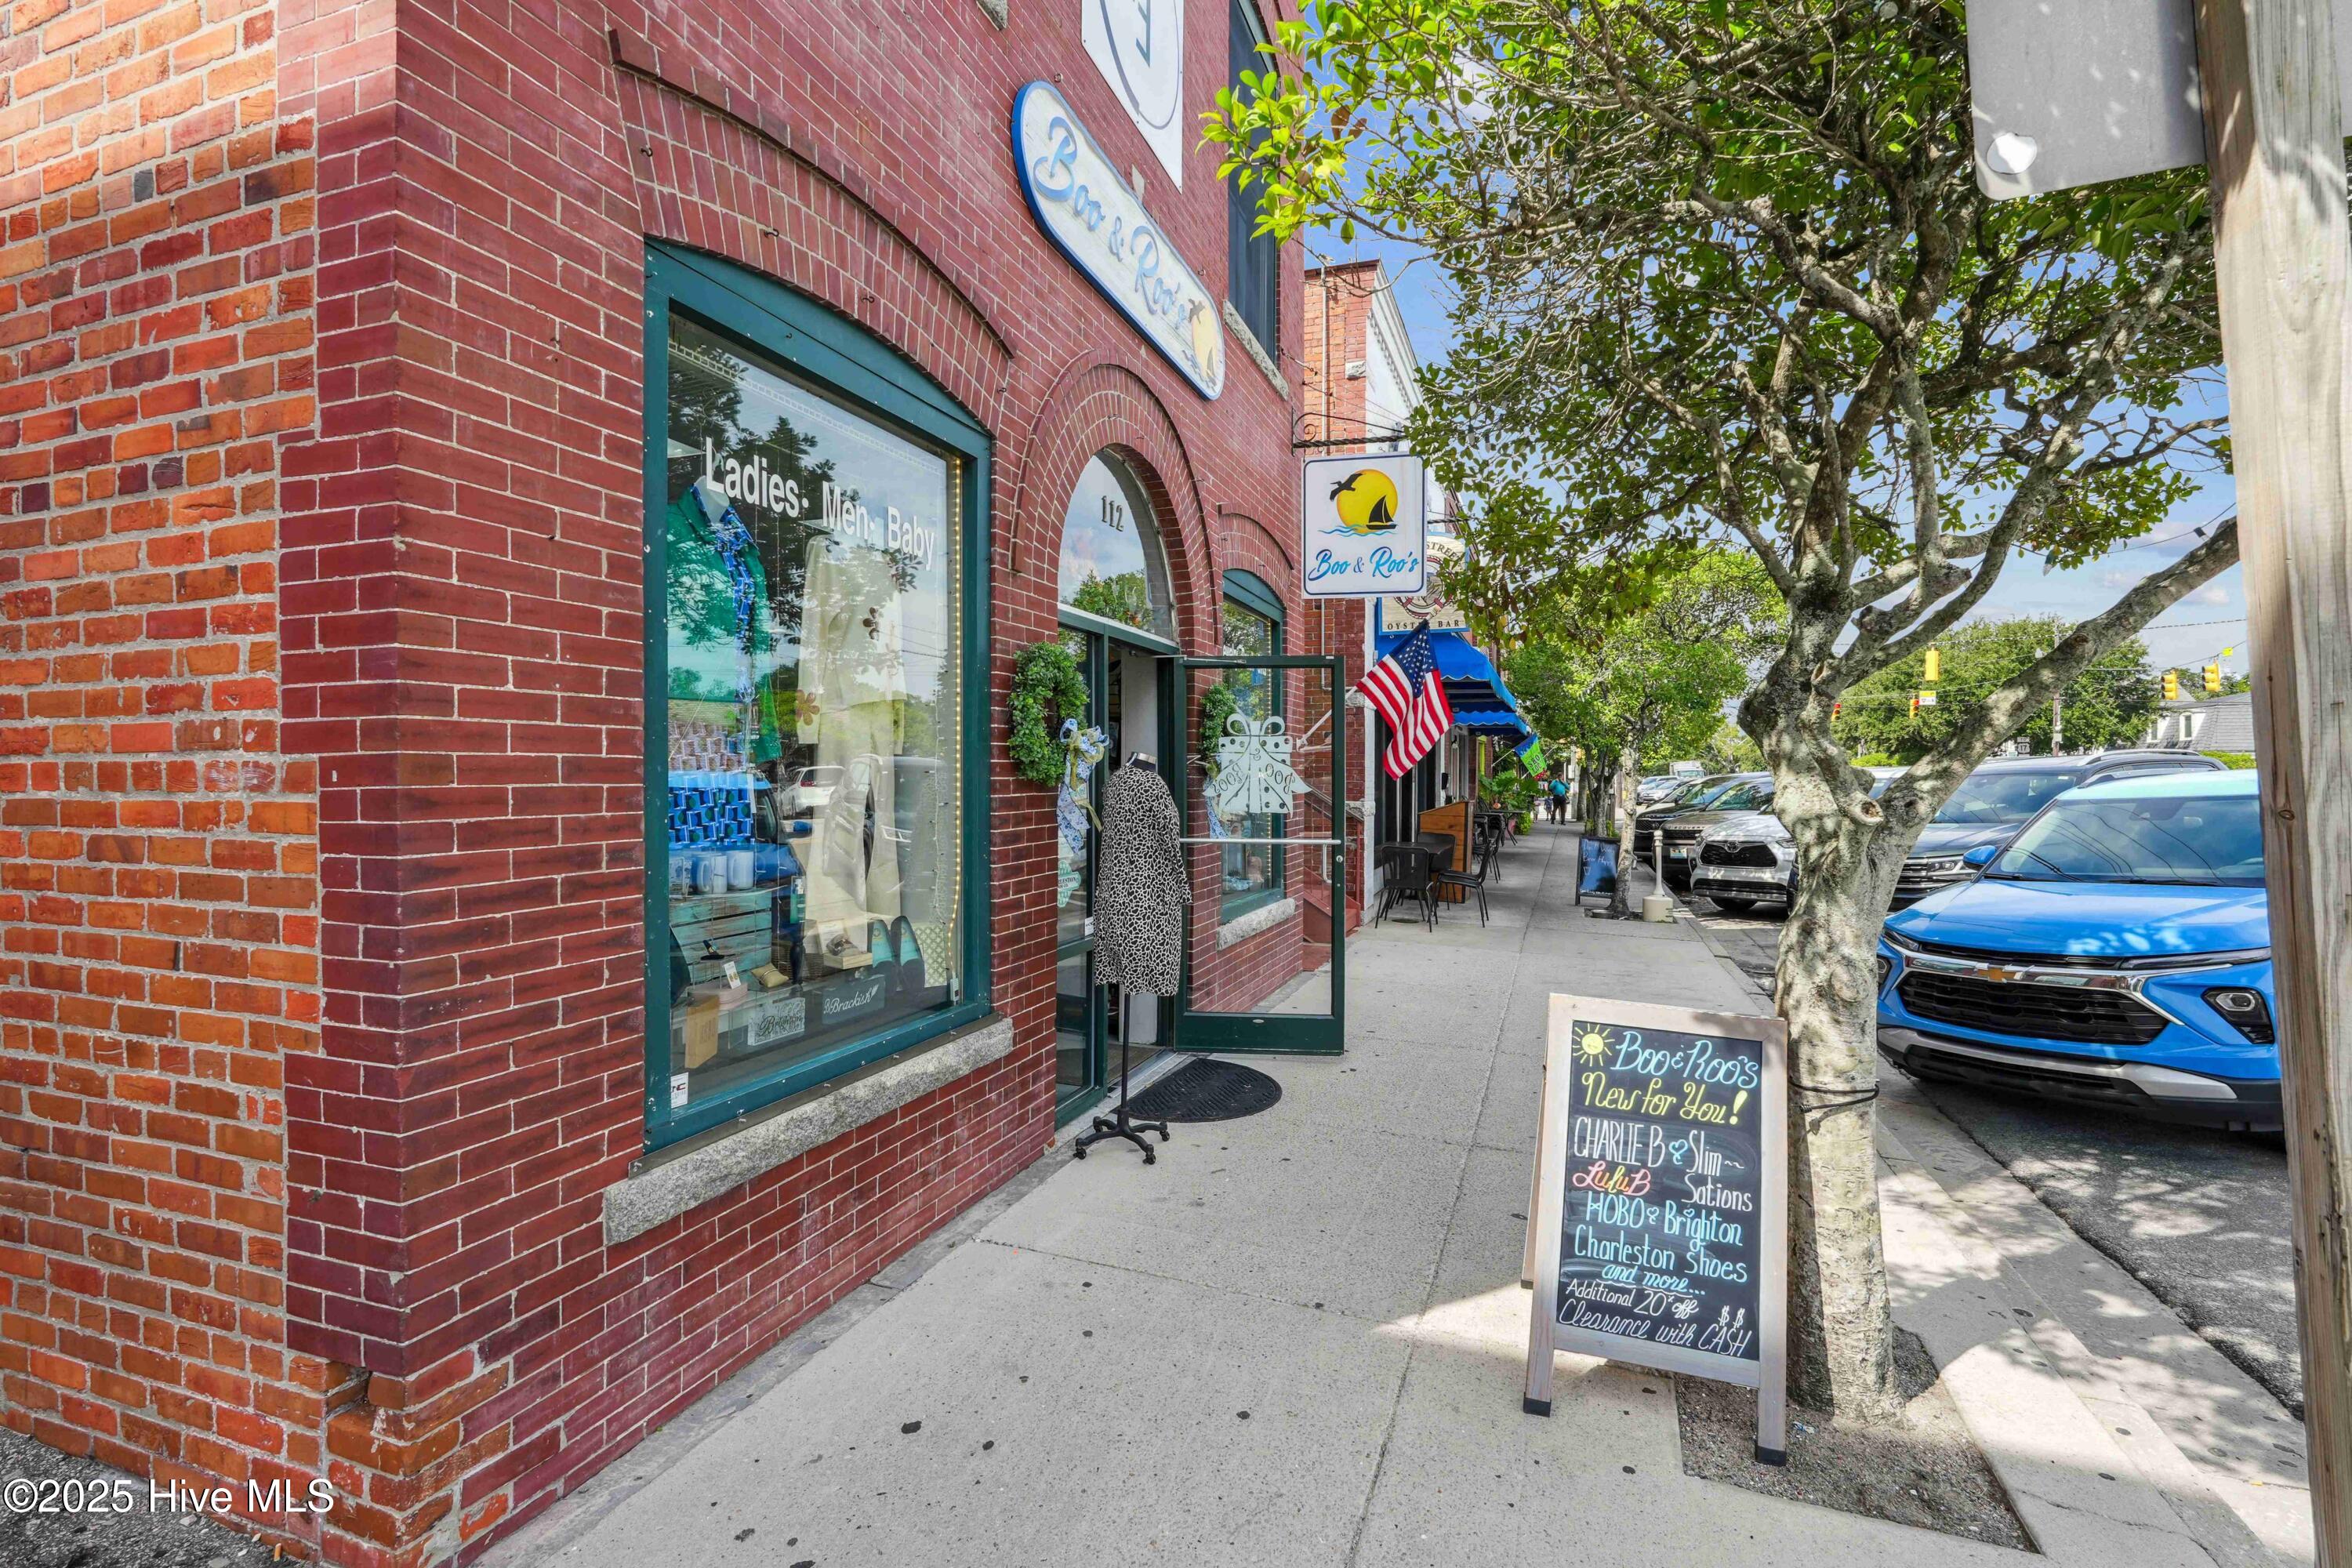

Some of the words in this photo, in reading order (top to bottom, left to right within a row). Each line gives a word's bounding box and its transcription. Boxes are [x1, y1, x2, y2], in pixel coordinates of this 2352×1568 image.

[1033, 116, 1106, 232] Boo
[1109, 216, 1124, 263] &
[1131, 225, 1187, 330] Roo's
[1102, 495, 1124, 532] 112
[887, 505, 935, 572] Baby
[1426, 541, 1458, 560] STREE
[1308, 549, 1350, 581] Boo
[1353, 557, 1364, 573] &
[1369, 546, 1419, 579] Roo's
[1387, 622, 1417, 630] OYST
[1528, 754, 1541, 768] SHO
[829, 988, 873, 1014] Brackish
[1610, 1031, 1671, 1076] Boo
[1683, 1040, 1759, 1089] Roo's
[1581, 1071, 1641, 1110] New
[1641, 1078, 1676, 1116] for
[1680, 1081, 1748, 1125] You!
[1574, 1117, 1644, 1166] CHARLIE
[1648, 1125, 1665, 1167] B
[1682, 1174, 1753, 1211] Sations
[1586, 1191, 1645, 1228] HOBO
[1664, 1200, 1743, 1252] Brighton
[1575, 1225, 1675, 1270] Charleston
[1602, 1265, 1637, 1283] and
[1566, 1279, 1636, 1308] Additional
[1671, 1299, 1699, 1319] off
[1559, 1299, 1651, 1339] Clearance
[1655, 1323, 1697, 1347] with
[1698, 1323, 1752, 1357] CASH
